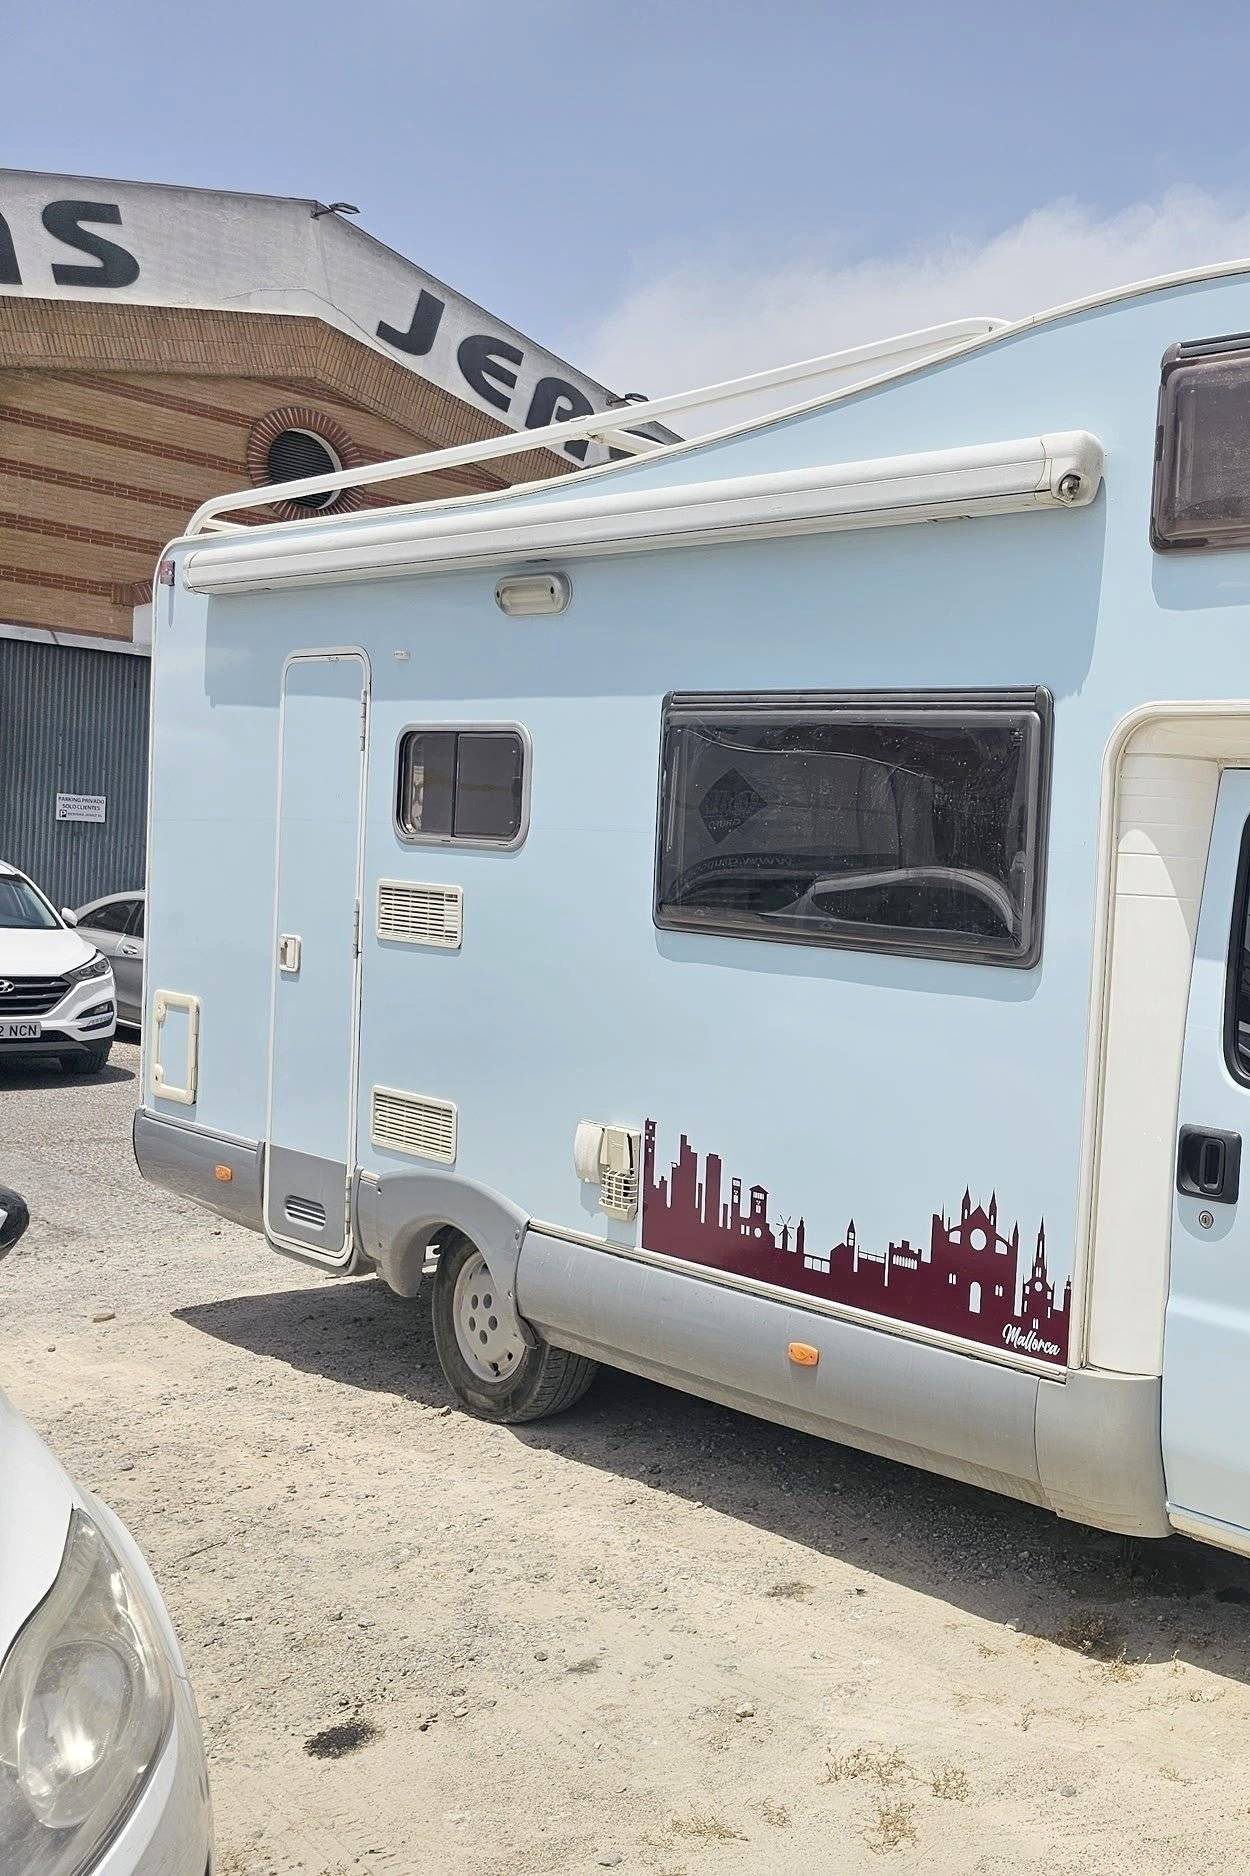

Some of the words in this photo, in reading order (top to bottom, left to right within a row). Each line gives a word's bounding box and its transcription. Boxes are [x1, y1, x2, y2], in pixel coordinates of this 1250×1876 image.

[0, 200, 139, 288] S
[376, 289, 665, 461] JER
[10, 1024, 37, 1037] NCN
[1001, 1323, 1061, 1356] Mallorca
